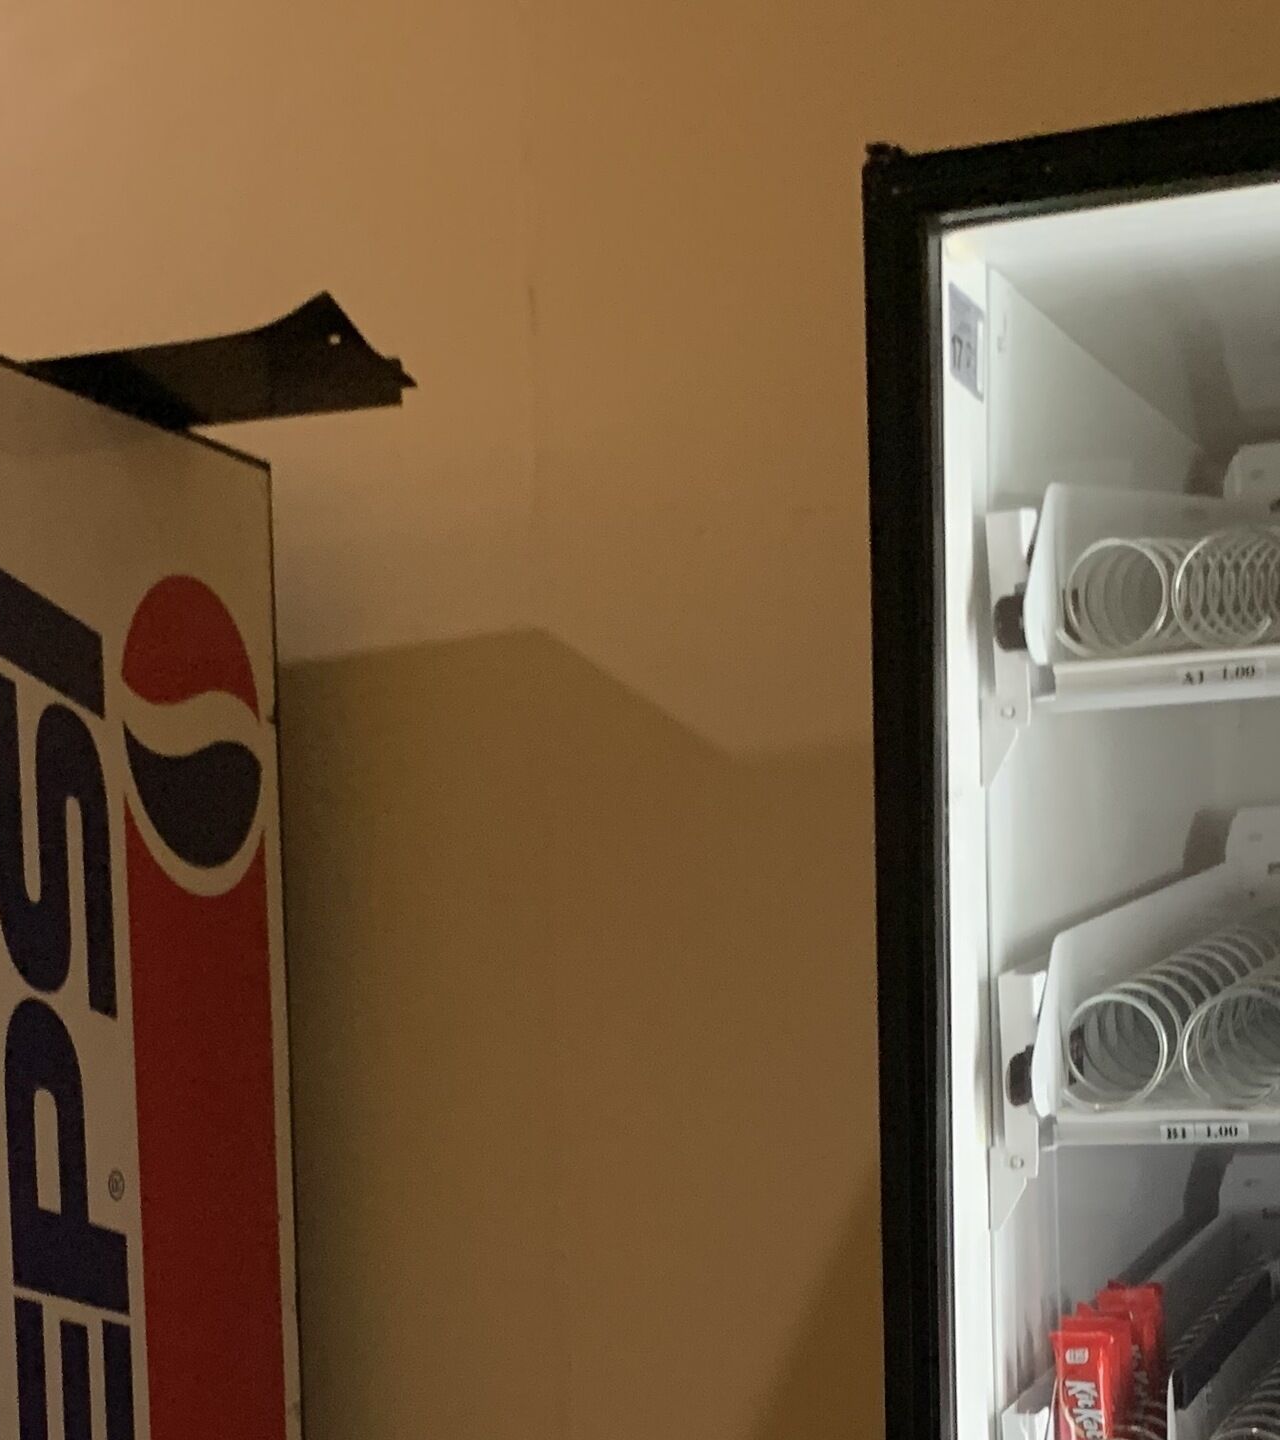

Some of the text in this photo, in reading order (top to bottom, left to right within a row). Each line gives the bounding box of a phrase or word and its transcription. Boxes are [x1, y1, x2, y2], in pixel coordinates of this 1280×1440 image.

[1180, 663, 1257, 686] A1 1.00
[1205, 1123, 1239, 1139] 1.00
